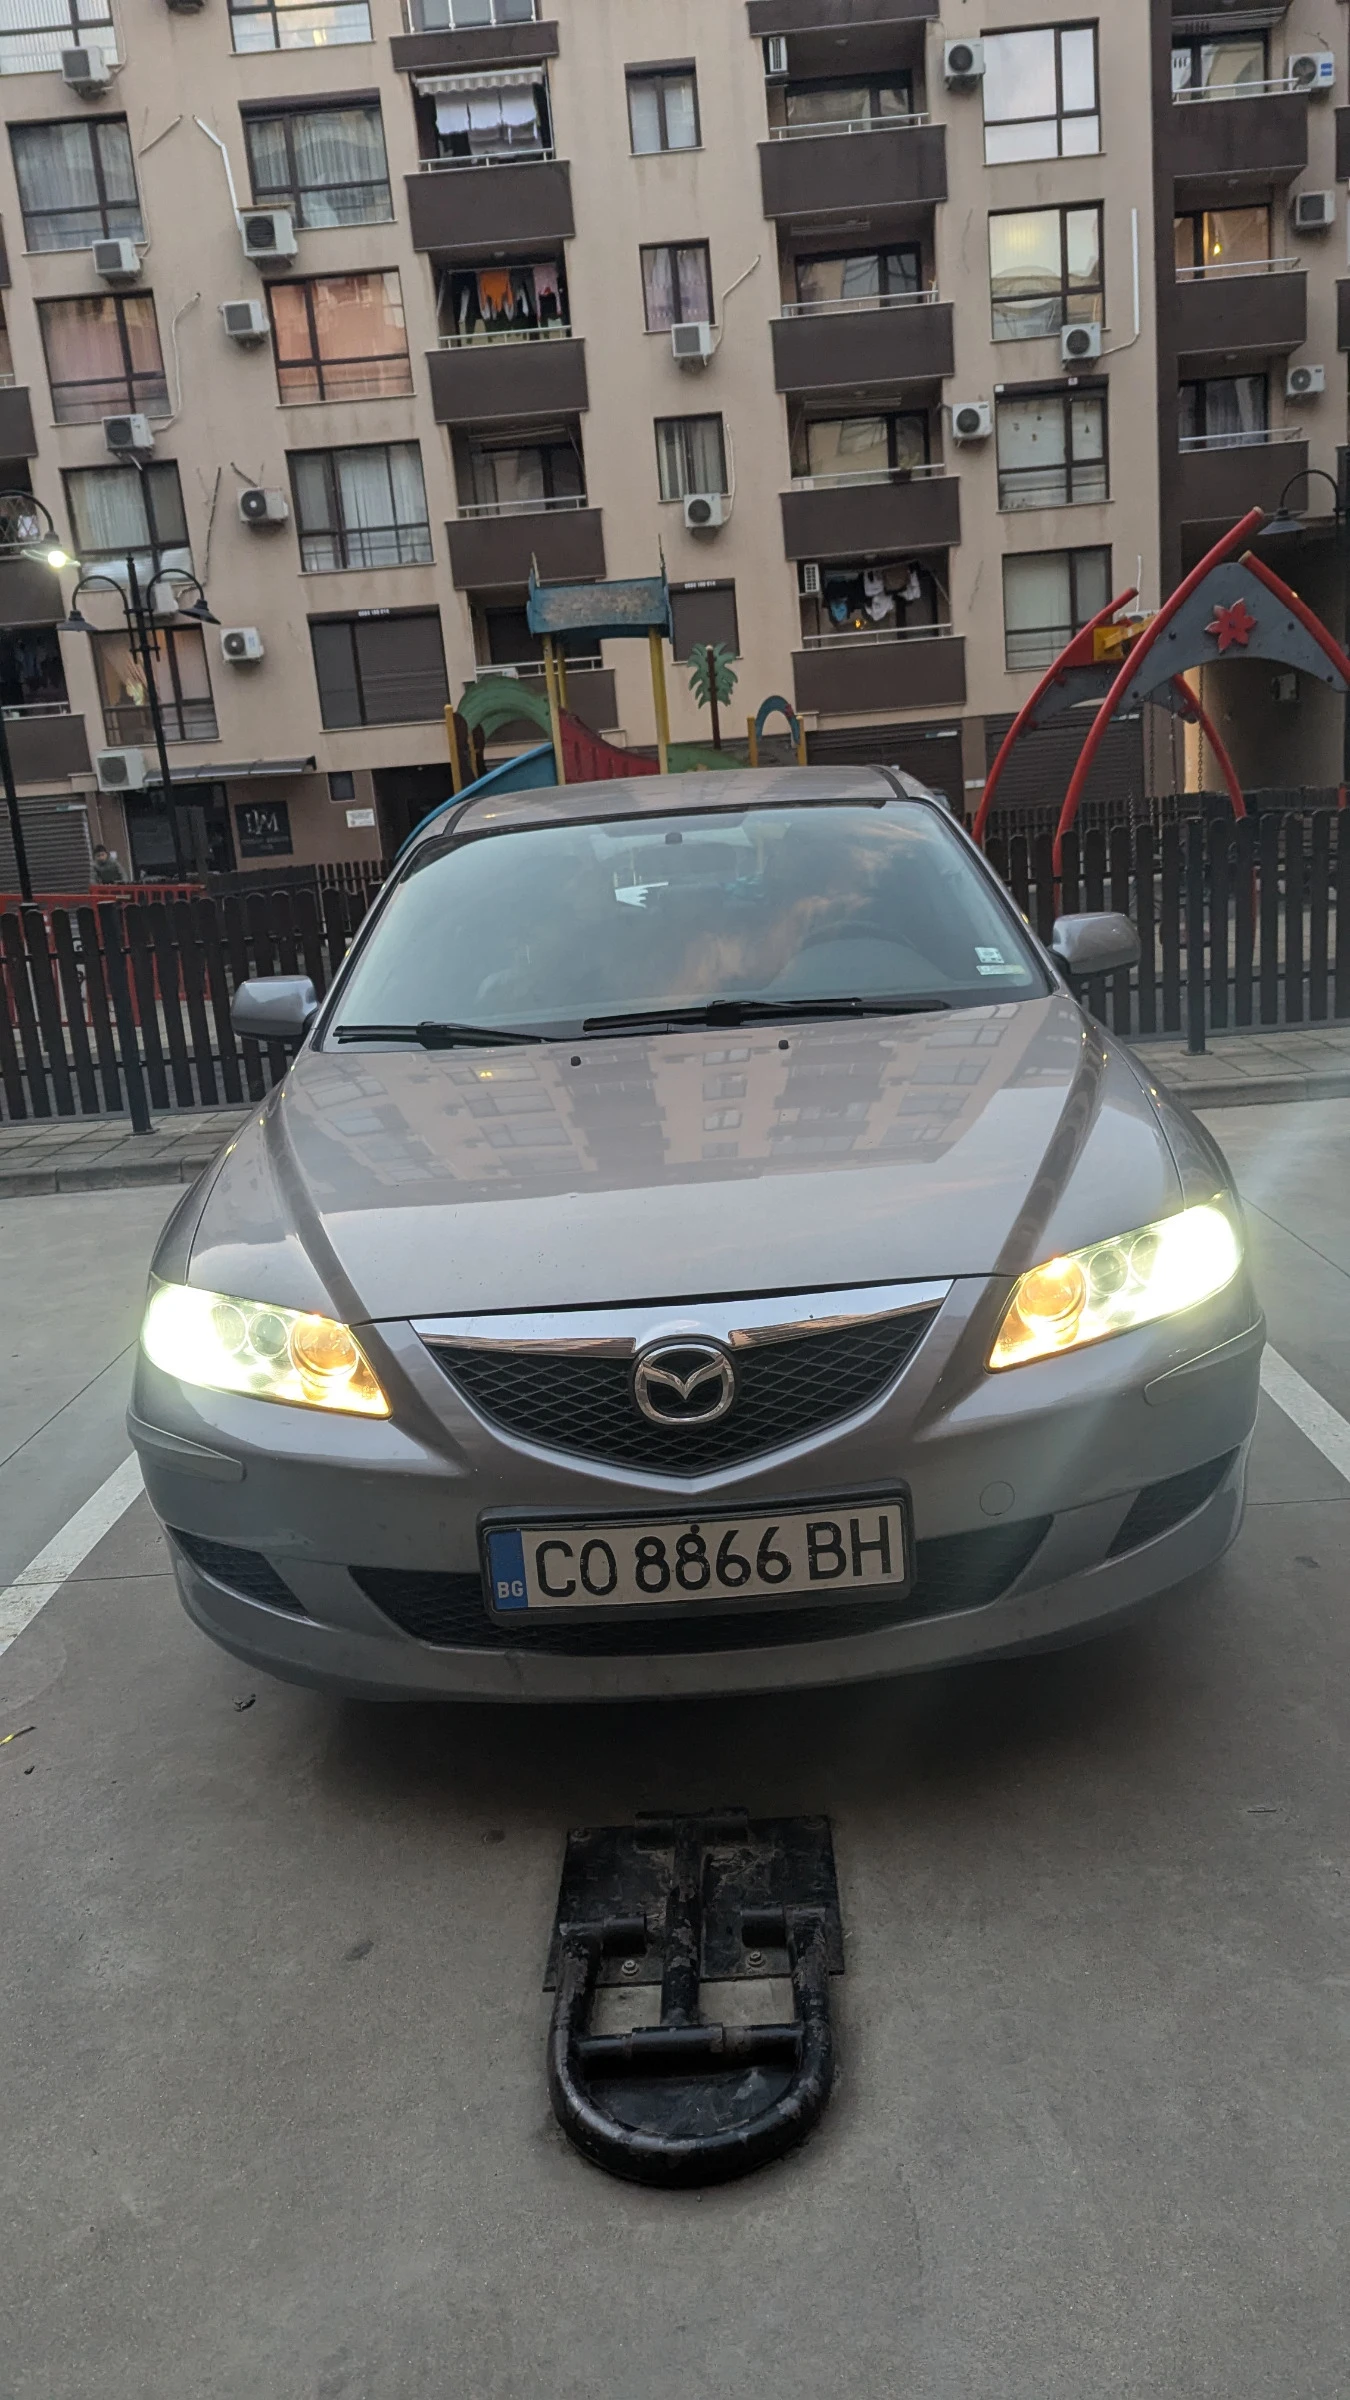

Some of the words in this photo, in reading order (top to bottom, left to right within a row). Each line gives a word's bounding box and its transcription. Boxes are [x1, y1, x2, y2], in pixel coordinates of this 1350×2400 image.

[535, 1538, 619, 1598] CO
[634, 1526, 793, 1594] 8866
[805, 1515, 892, 1580] BH
[497, 1580, 523, 1599] BG
